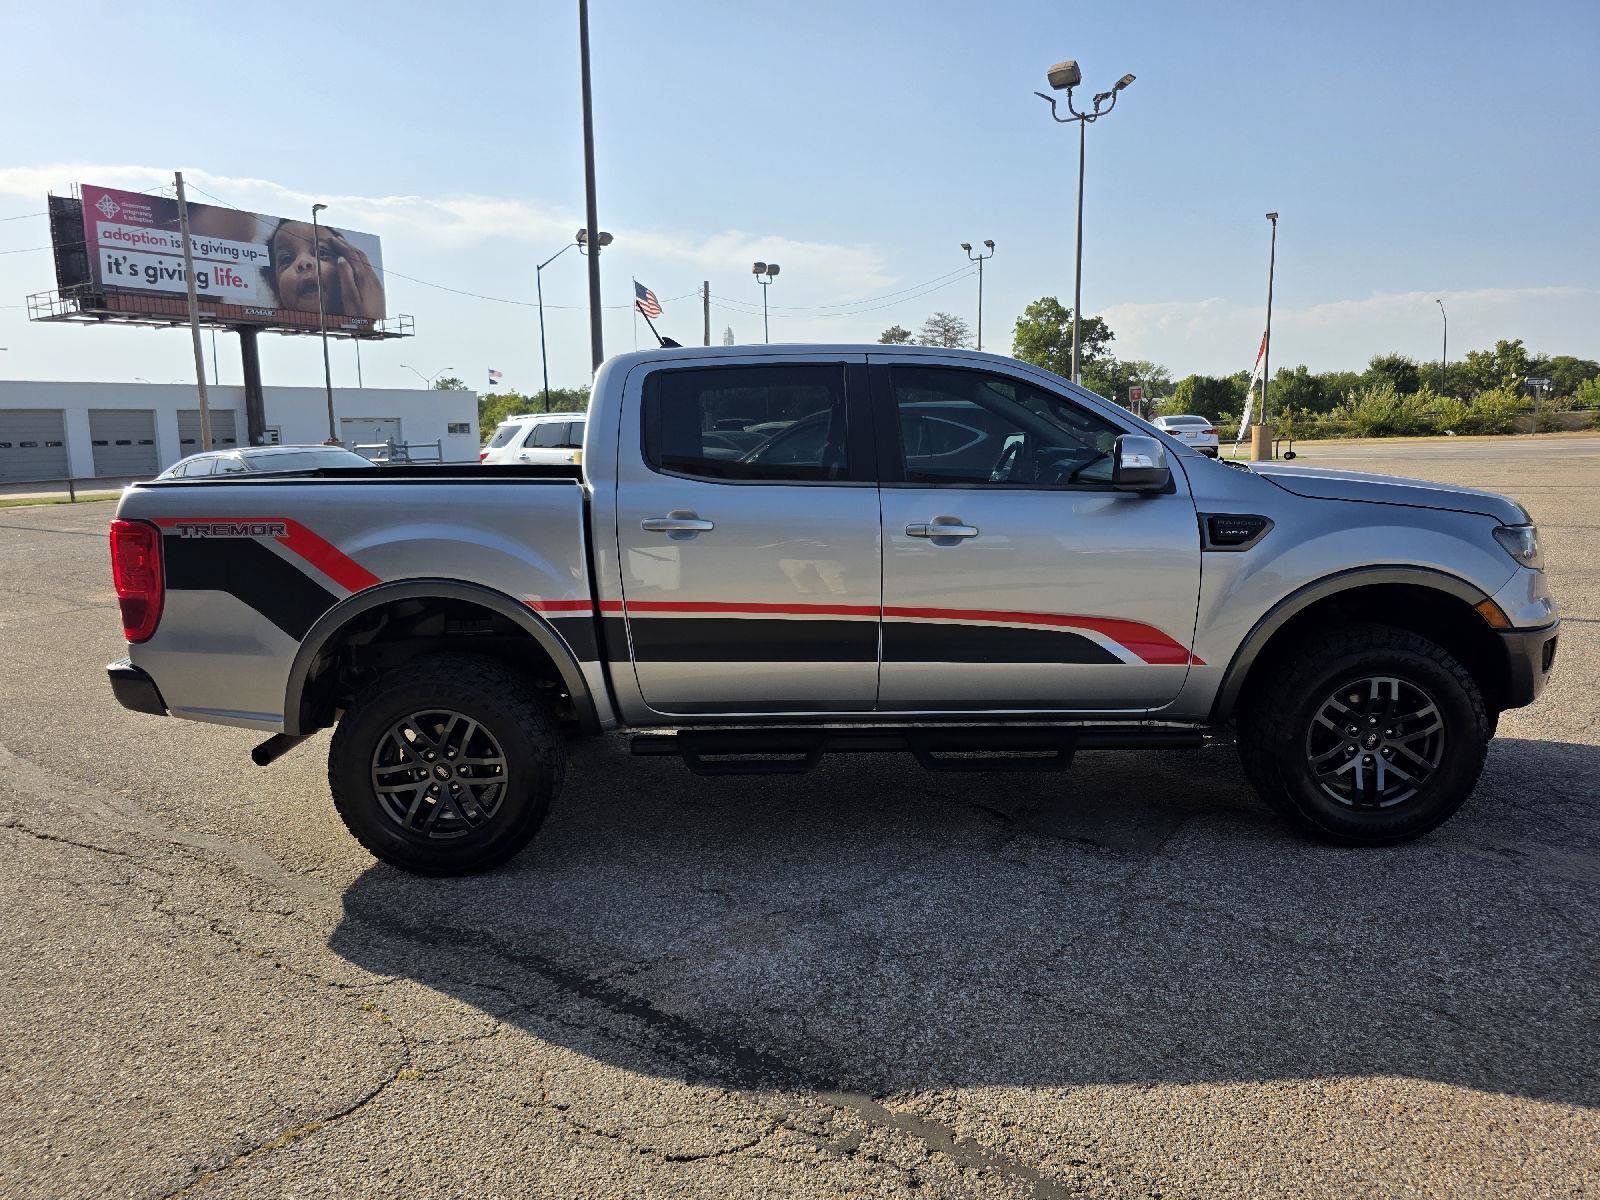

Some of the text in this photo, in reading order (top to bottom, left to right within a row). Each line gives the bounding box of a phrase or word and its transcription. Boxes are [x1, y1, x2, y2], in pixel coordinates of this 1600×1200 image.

[102, 227, 167, 246] adoption
[170, 235, 198, 250] is't
[200, 241, 239, 259] giving
[213, 266, 249, 288] life.
[176, 523, 288, 538] TREMOR
